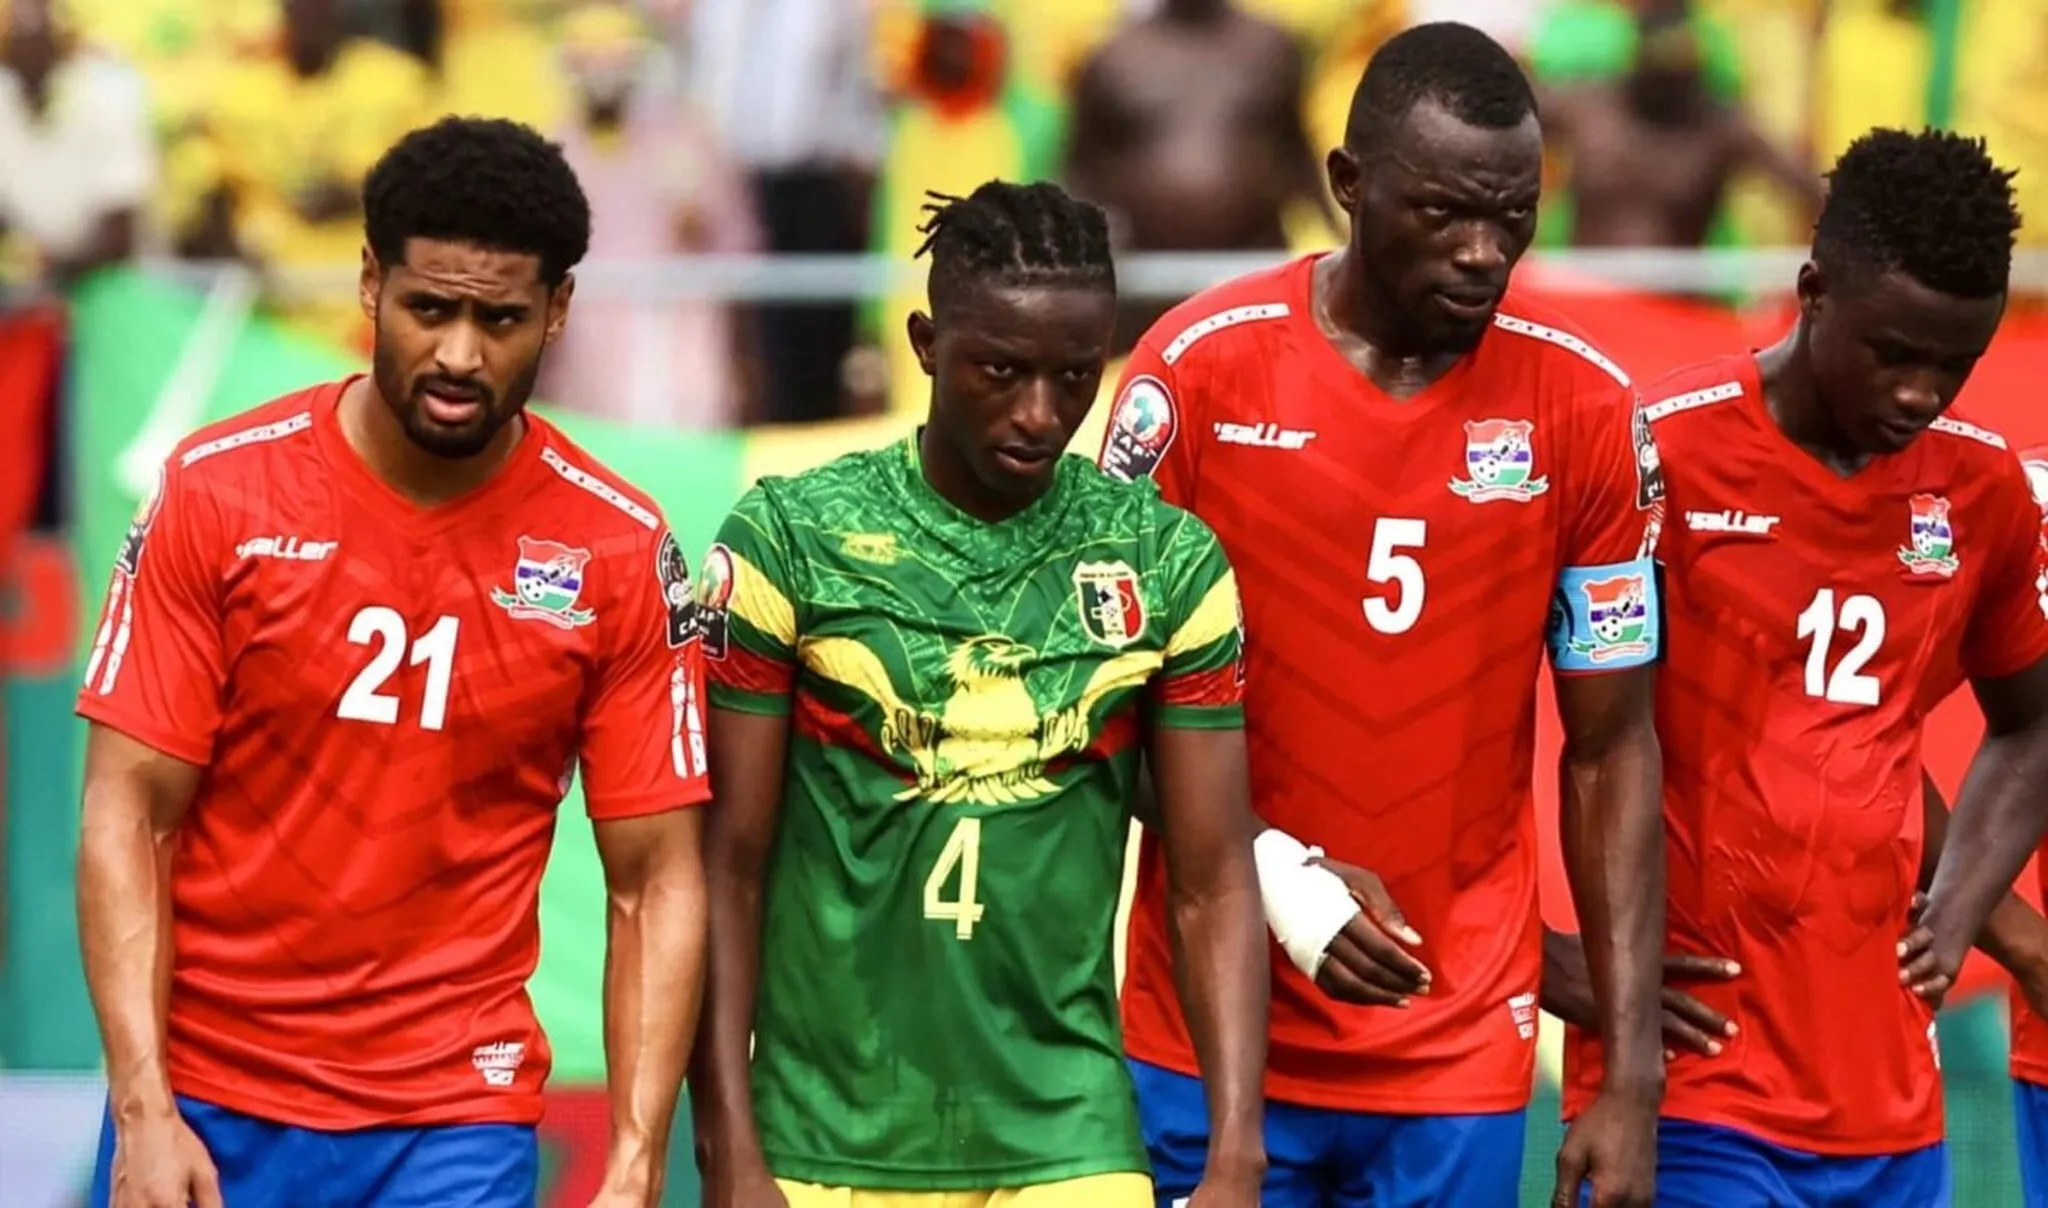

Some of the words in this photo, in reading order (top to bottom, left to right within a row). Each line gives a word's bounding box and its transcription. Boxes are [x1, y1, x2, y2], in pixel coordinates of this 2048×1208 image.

[1213, 422, 1316, 449] saller
[1362, 517, 1427, 634] 5
[1685, 509, 1780, 534] saller
[337, 606, 459, 730] 21
[1797, 588, 1885, 705] 12
[923, 816, 985, 940] 4
